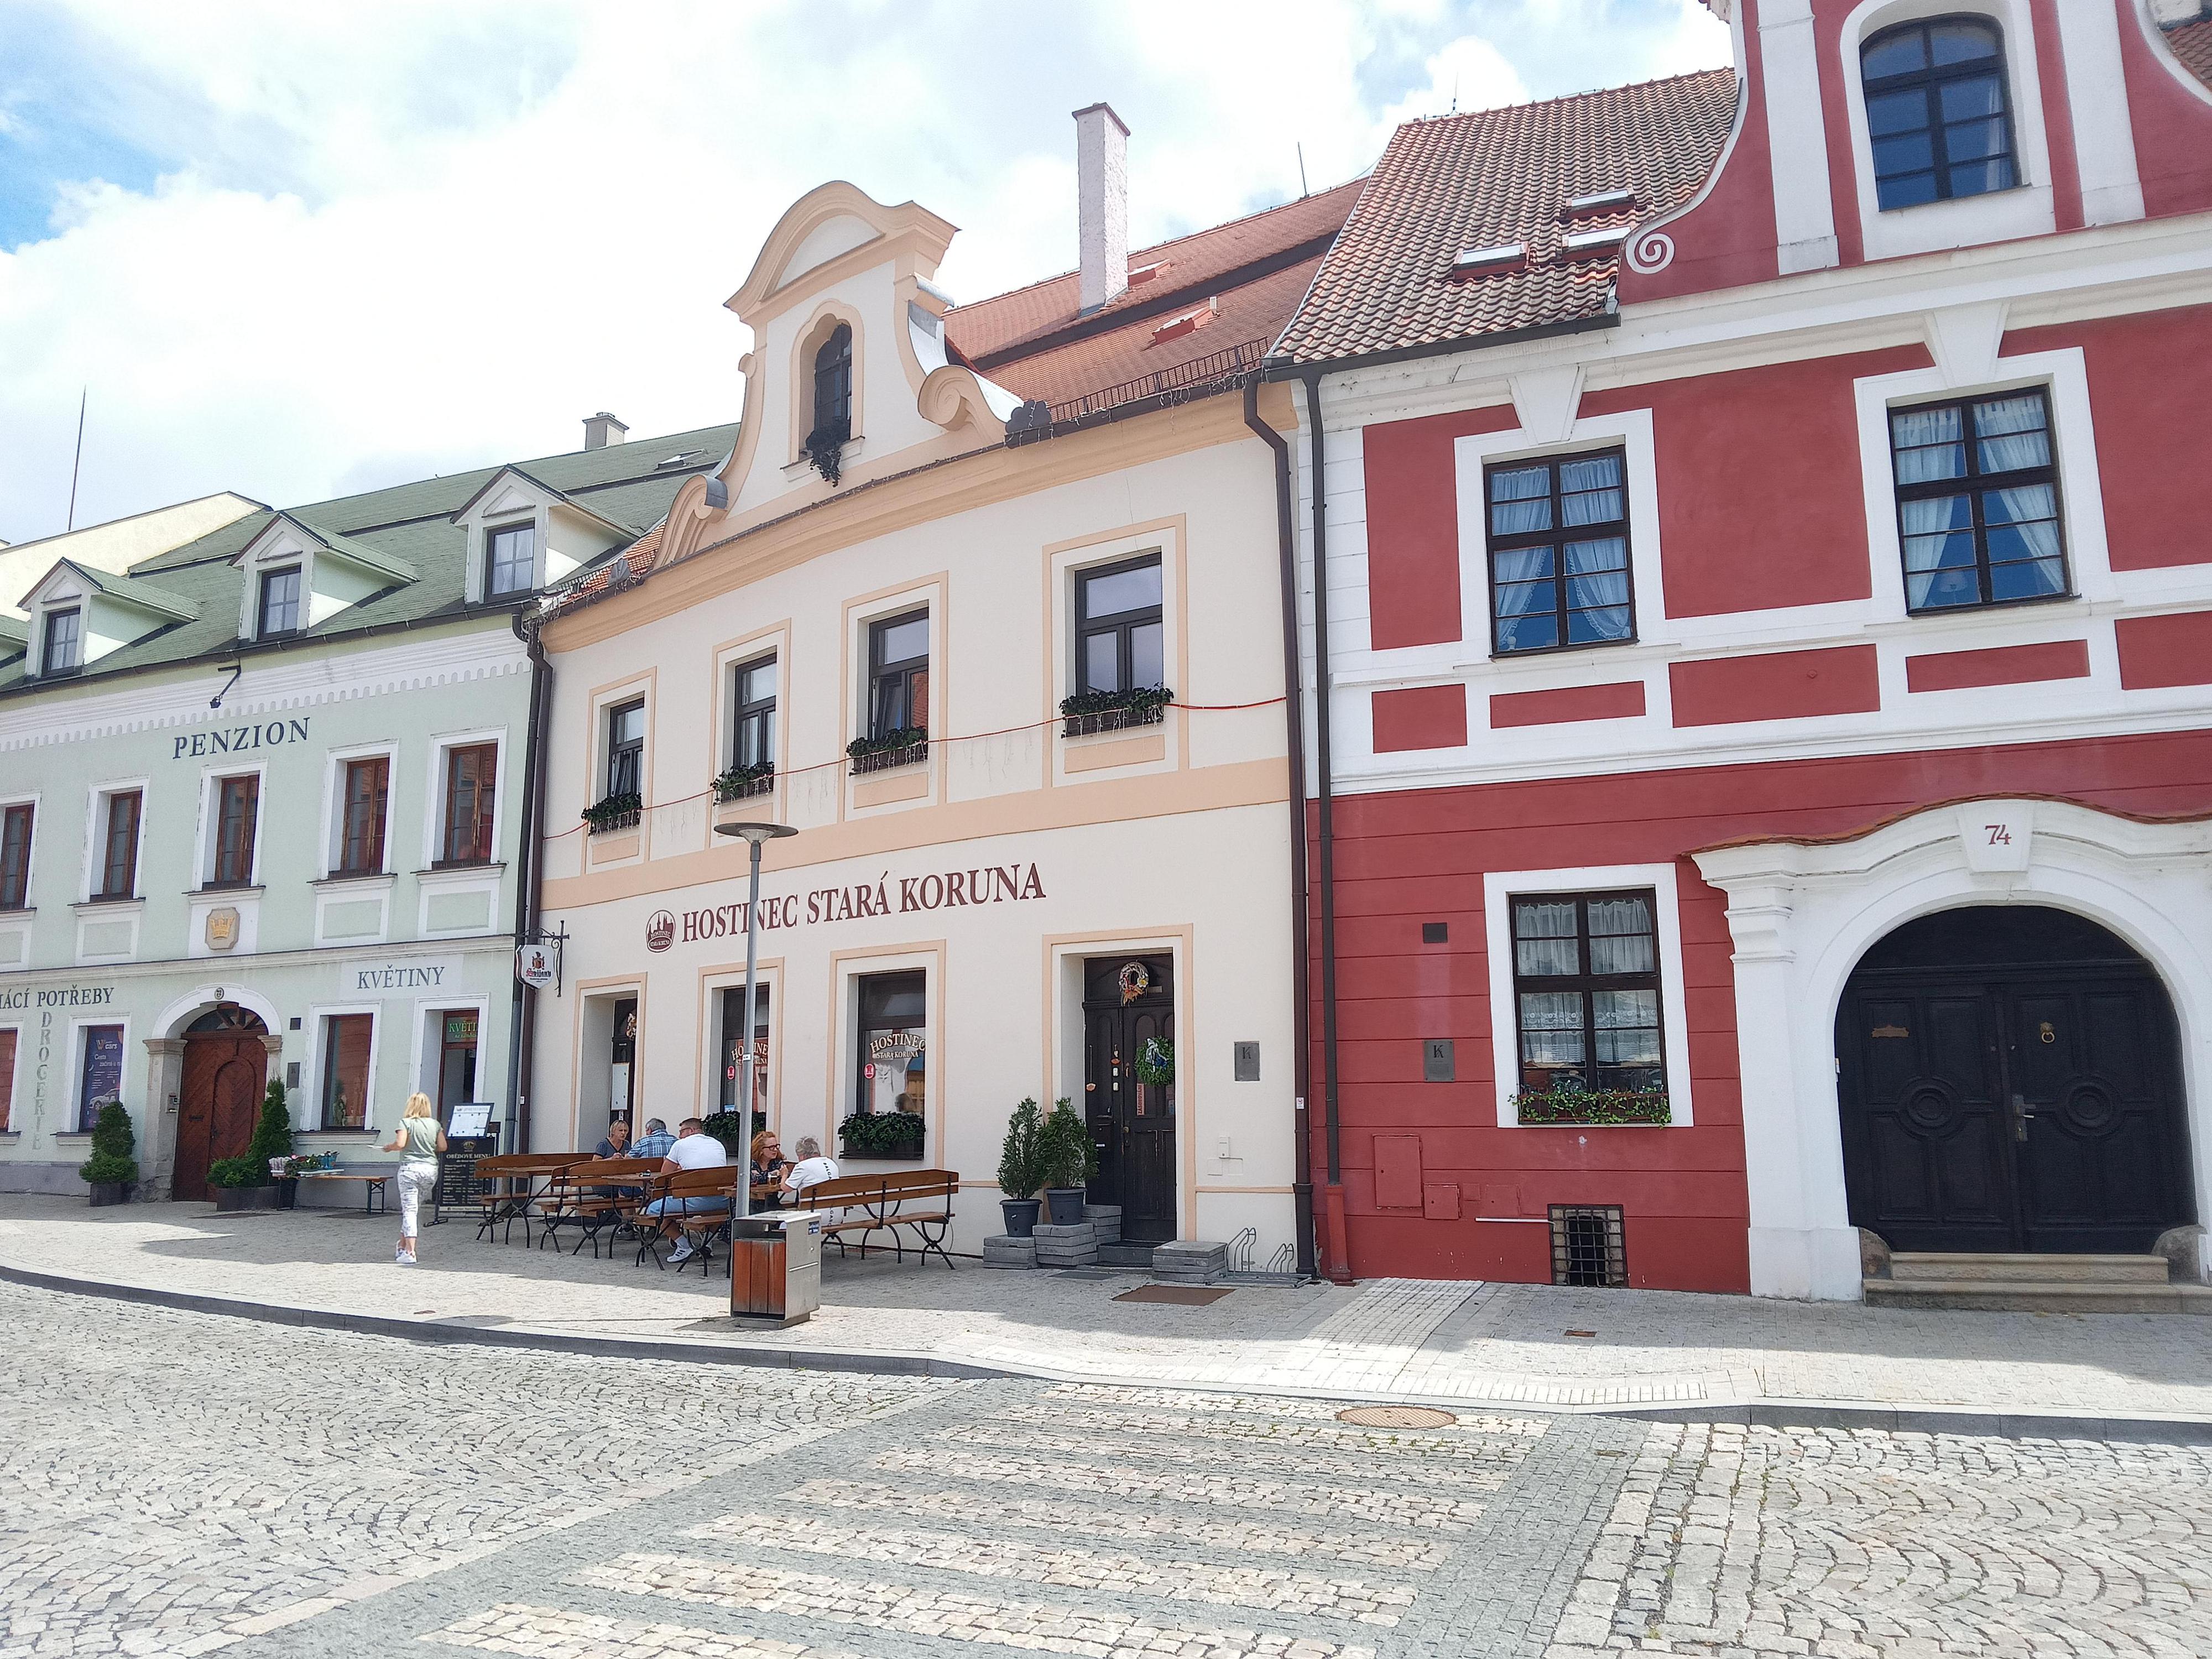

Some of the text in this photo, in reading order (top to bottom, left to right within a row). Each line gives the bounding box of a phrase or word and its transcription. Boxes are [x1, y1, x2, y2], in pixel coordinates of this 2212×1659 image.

[173, 717, 310, 759] PENZION
[1985, 824, 2012, 845] 74
[682, 863, 1046, 942] HOSTINEC STARÁ KORUNA
[357, 964, 445, 989] KVĚTINY
[36, 984, 114, 1008] POTŘEBY
[448, 1020, 478, 1032] KVĚTI
[731, 1042, 768, 1061] HOINE
[869, 1033, 926, 1053] HOSTINEC
